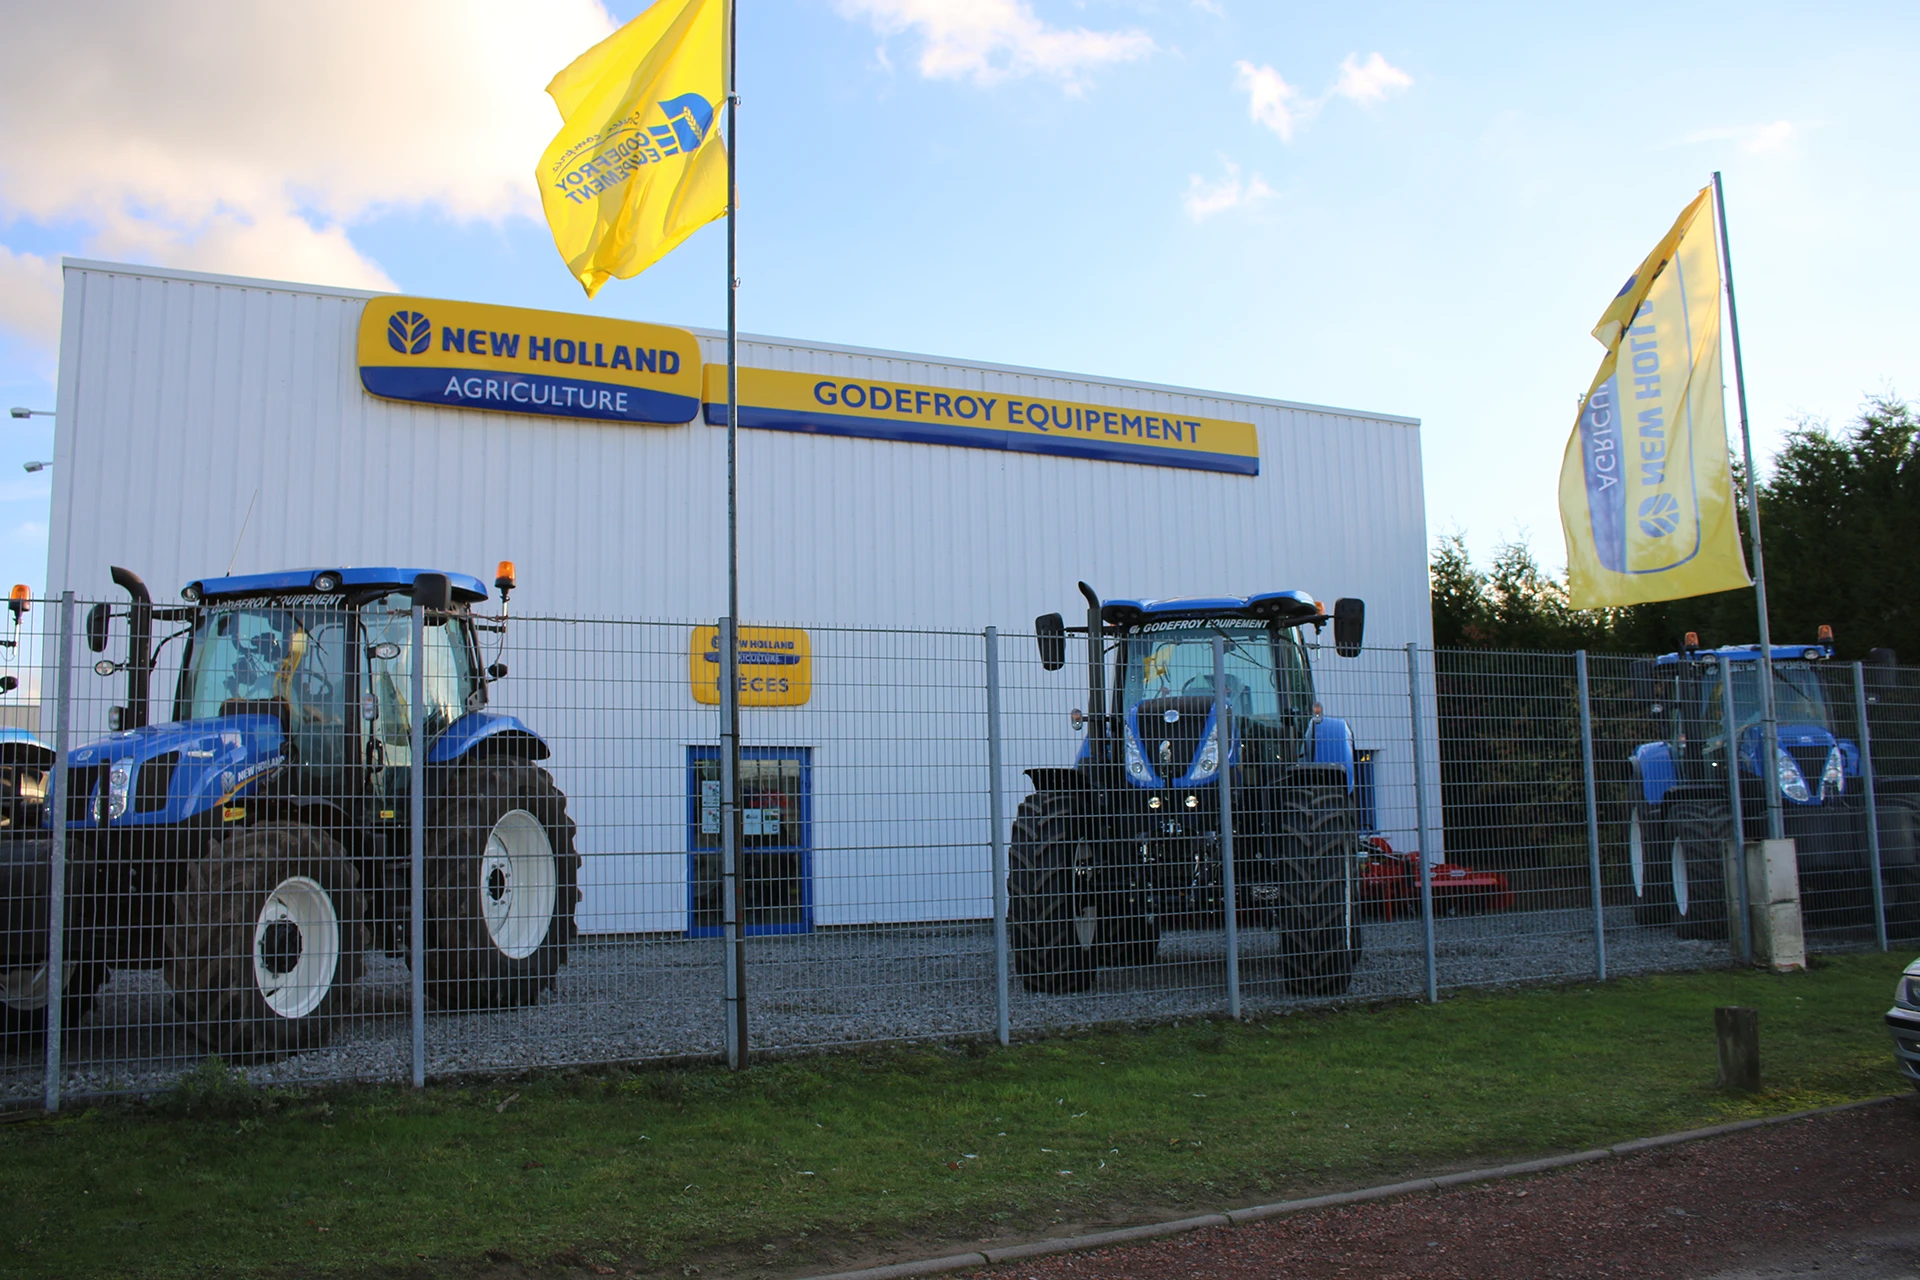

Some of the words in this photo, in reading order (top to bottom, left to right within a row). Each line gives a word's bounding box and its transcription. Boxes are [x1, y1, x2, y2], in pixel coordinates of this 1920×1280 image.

[441, 326, 520, 358] NEW
[528, 335, 681, 375] HOLLAND
[443, 376, 628, 413] AGRICULTURE
[813, 380, 997, 422] GODEFROY
[1007, 400, 1202, 444] EQUIPEMENT
[1143, 619, 1206, 633] GODEFROY
[749, 640, 794, 649] HOLLAND
[716, 673, 789, 693] ÈCES
[237, 765, 255, 782] NEW
